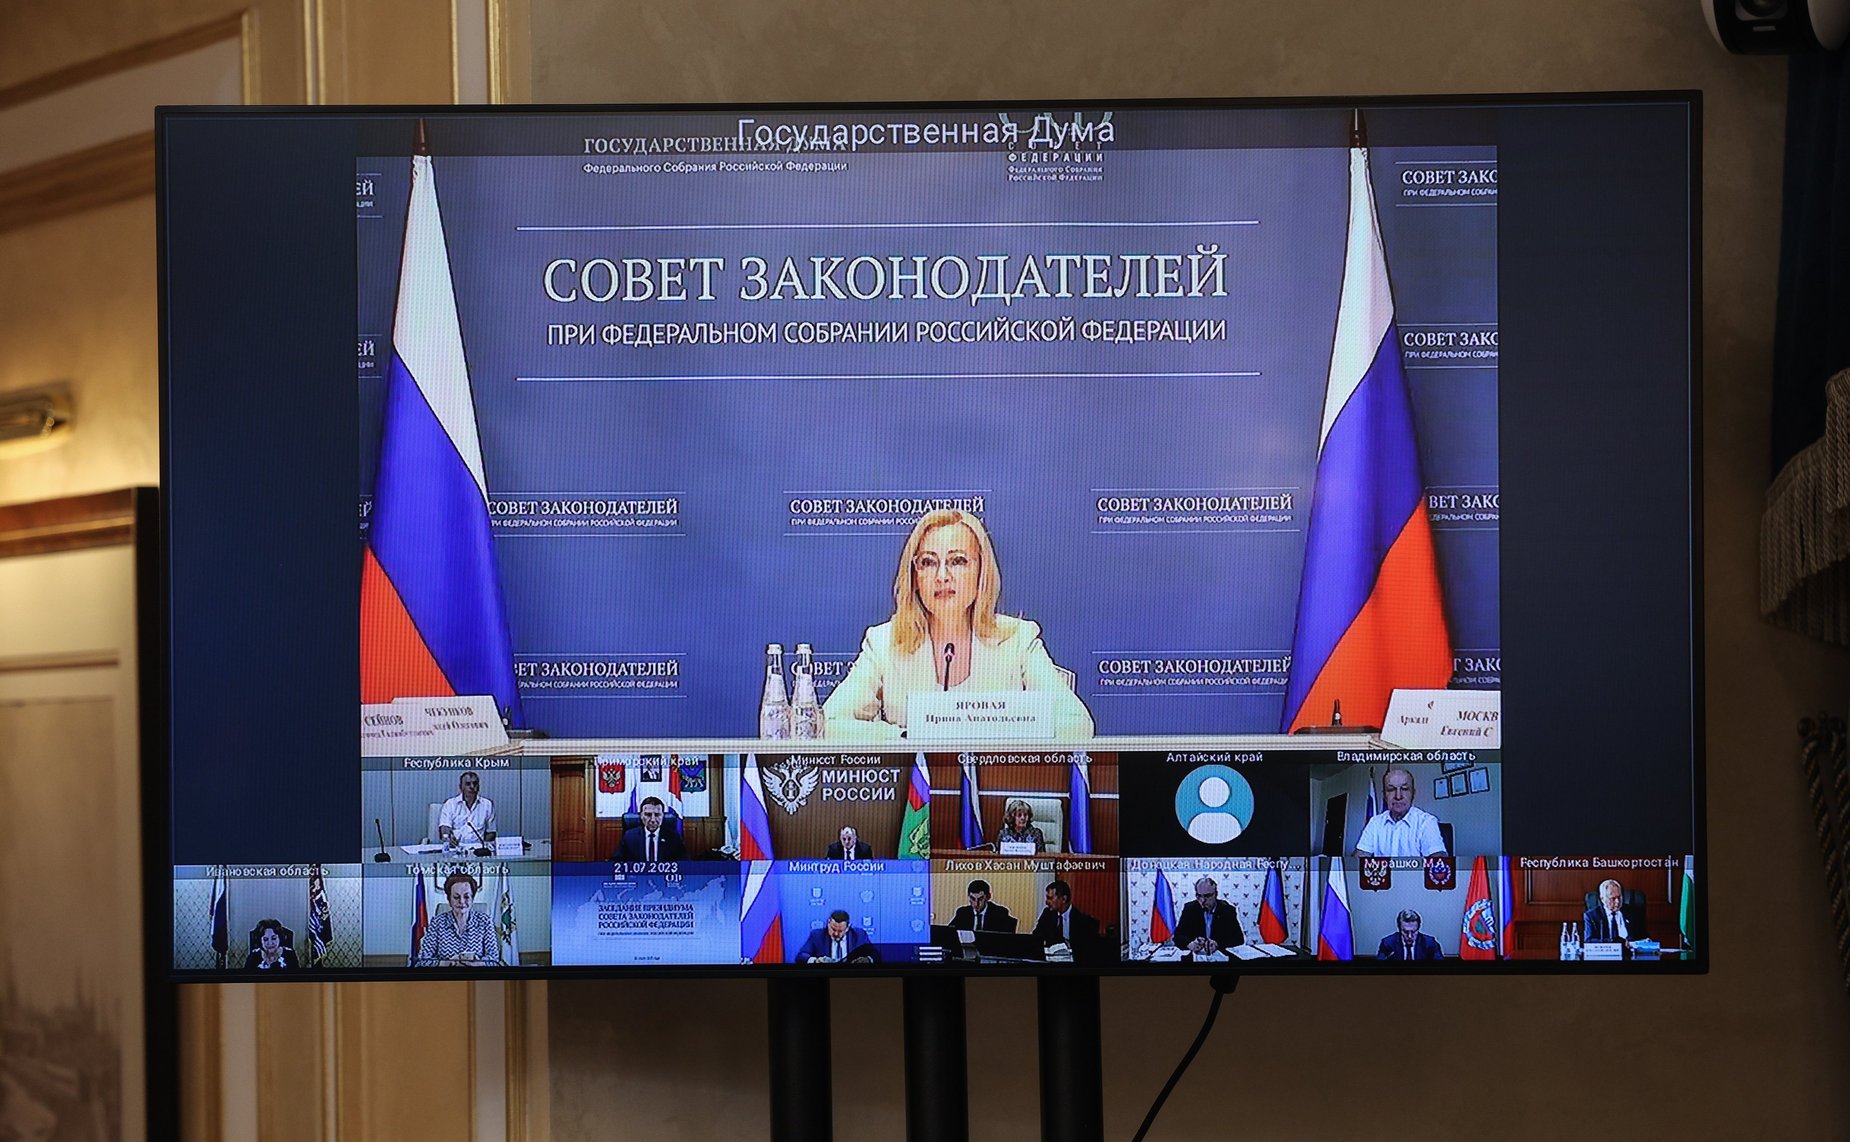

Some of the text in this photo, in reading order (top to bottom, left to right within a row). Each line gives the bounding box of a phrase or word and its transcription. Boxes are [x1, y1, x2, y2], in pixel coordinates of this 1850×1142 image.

[739, 117, 1115, 151] Государственная Дума
[1008, 153, 1103, 163] ФЕДЕРАЦИИ
[583, 159, 848, 173] Федерального Собрания Российской Федерации
[1402, 170, 1455, 184] СОВЕТ
[543, 244, 1228, 307] СОВЕТ ЗАКОНОДАТЕЛЕЙ
[548, 316, 1226, 348] ПРИ ФЕДЕРАЛЬНОМ СОБРАНИИ РОССИЙСКОЙ ФЕДЕРАЦИИ
[1404, 332, 1457, 346] СОВЕТ
[488, 498, 678, 516] СОВЕТ ЗАКОНОДАТЕЛЕЙ
[790, 496, 985, 514] СОВЕТ ЗАКОНОДАТЕЛЕЙ
[1097, 493, 1292, 512] СОВЕТ ЗАКОНОДАТЕЛЕЙ
[1429, 494, 1458, 509] ВЕТ
[541, 660, 678, 677] ЗАКОНОДАТЕЛЕЙ
[791, 661, 843, 675] СВЕТ
[1099, 656, 1291, 674] СОВЕТ ЗАКОНОДАТЕЛЕЙ
[956, 701, 1006, 710] ЯРОВАЯ
[926, 714, 961, 724] Ирина
[404, 756, 510, 770] Республика Крым
[791, 754, 881, 765] Минюст России
[957, 752, 1093, 766] Свердловская область
[1166, 752, 1263, 764] Алтайский край
[1337, 750, 1476, 763] Владимирская область
[822, 769, 901, 783] МИНЮСТ
[822, 787, 896, 801] РОССИИ
[614, 862, 679, 873] 21.07.2023
[789, 860, 884, 874] Минтруд России
[945, 860, 982, 871] Лихов
[984, 860, 1021, 871] Хасан
[1520, 856, 1679, 870] Республика Башкортостан
[206, 864, 329, 877] Ивановская область
